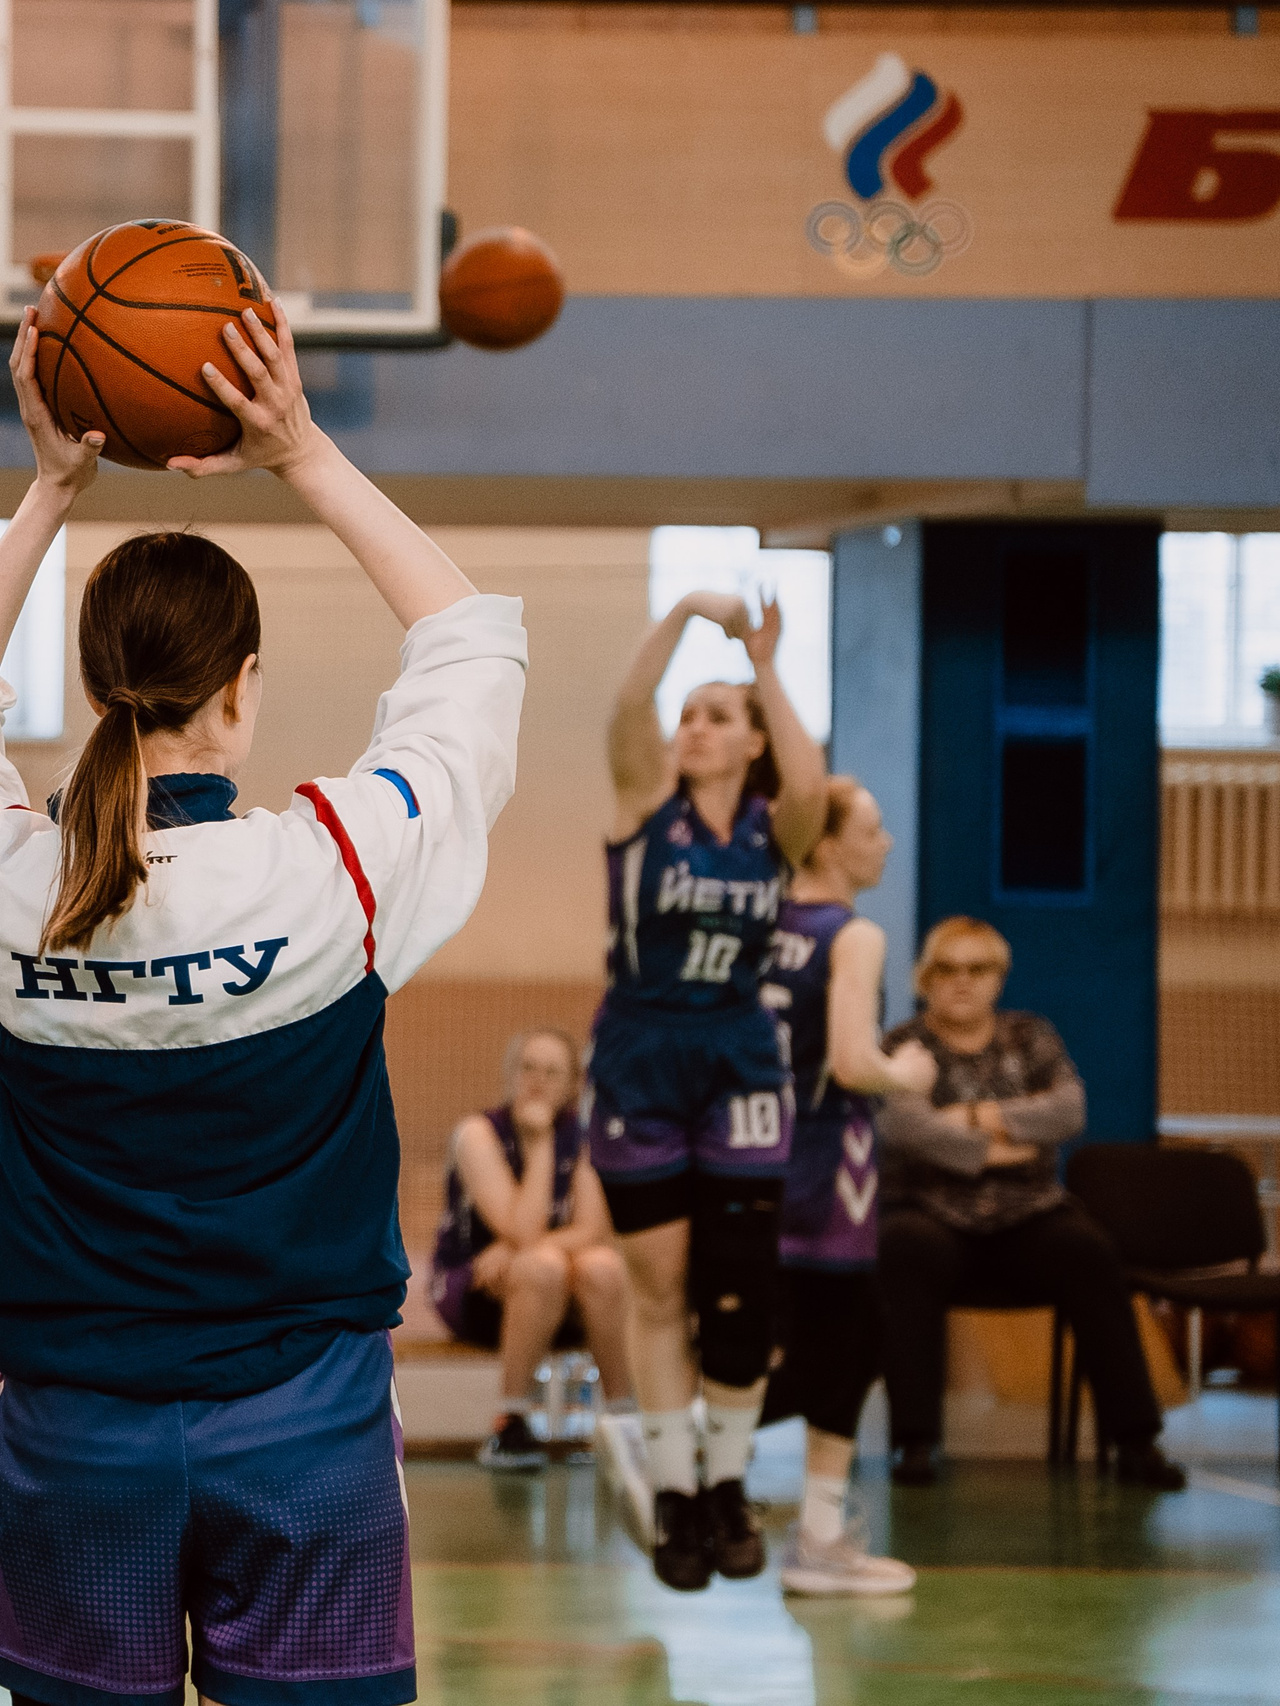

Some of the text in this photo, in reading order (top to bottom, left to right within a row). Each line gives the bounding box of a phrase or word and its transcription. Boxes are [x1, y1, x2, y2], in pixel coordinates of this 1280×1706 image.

[11, 936, 289, 1005] НГТУ
[680, 930, 742, 983] 10
[728, 1091, 781, 1149] 10
